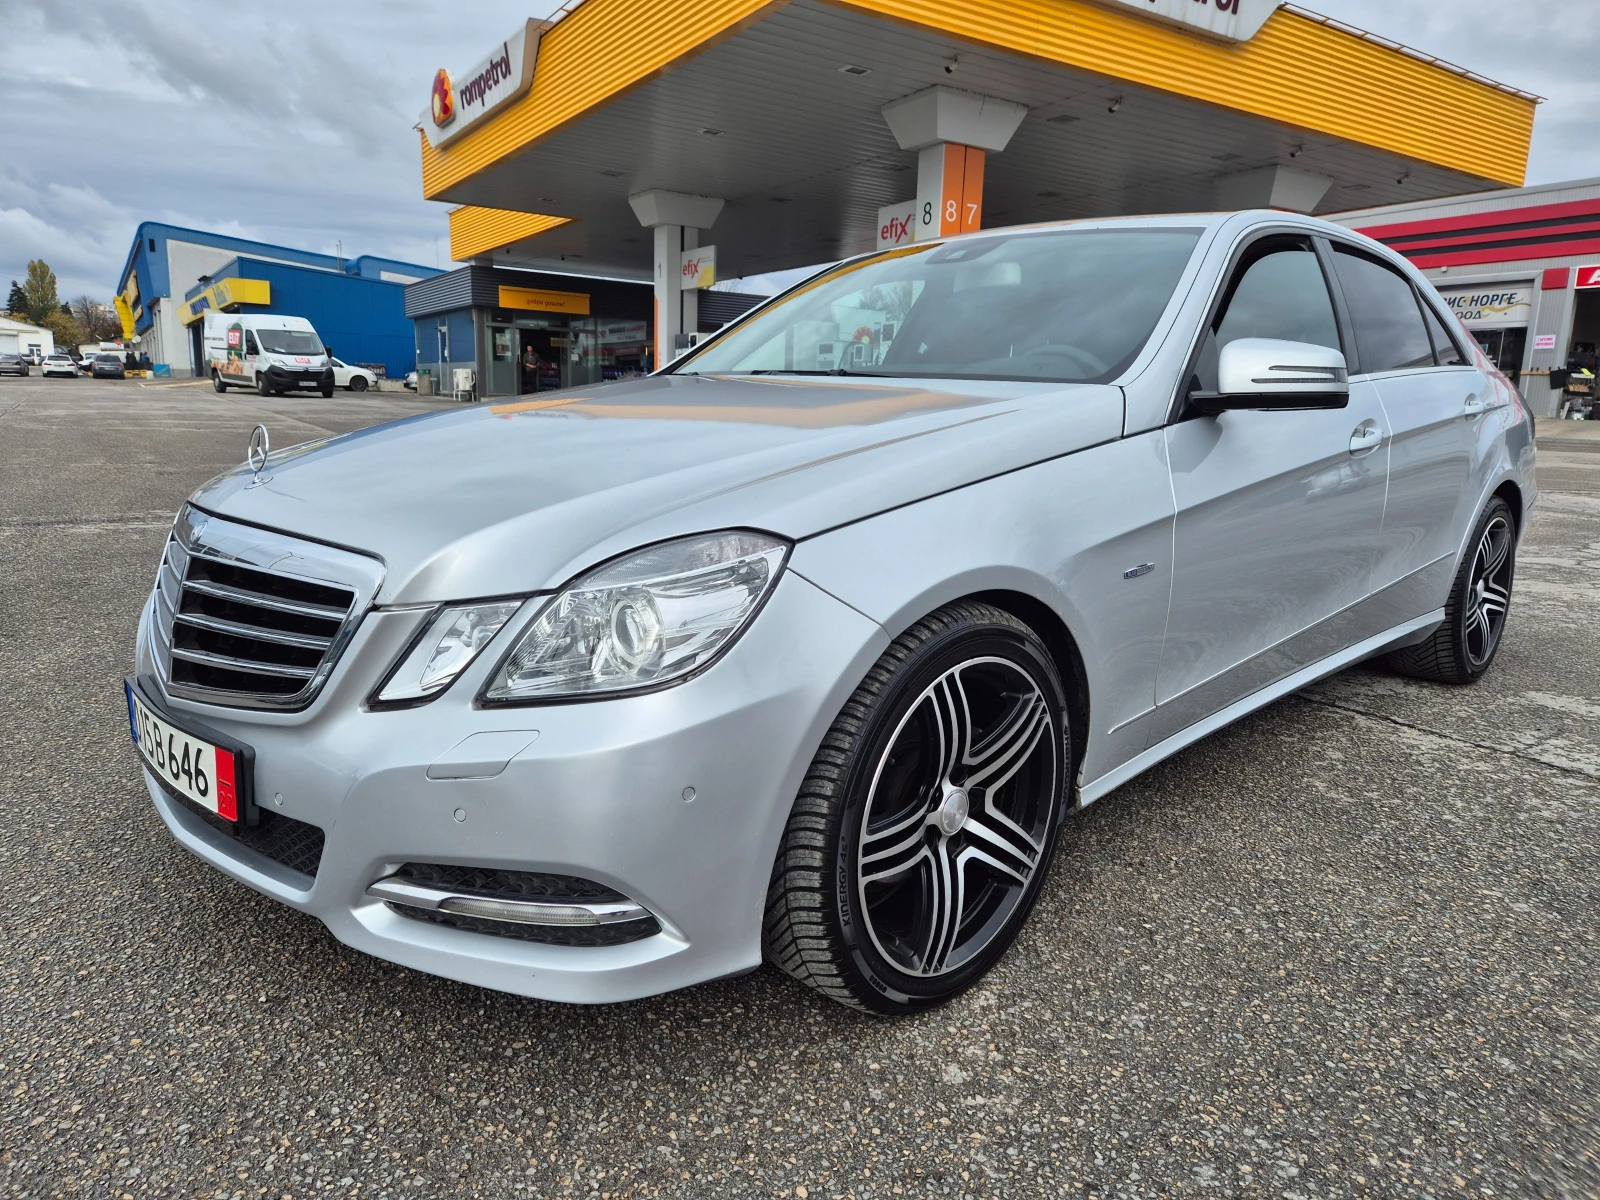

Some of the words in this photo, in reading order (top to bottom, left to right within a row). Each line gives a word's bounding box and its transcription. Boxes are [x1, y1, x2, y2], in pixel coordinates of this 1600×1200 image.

[460, 41, 511, 110] rompetrol
[922, 202, 932, 225] 8
[945, 200, 957, 222] 8
[966, 203, 978, 225] 7
[881, 213, 912, 243] efix
[658, 262, 662, 278] 1
[682, 257, 701, 279] efix
[1468, 292, 1518, 307] НОРГЕ
[839, 865, 851, 927] KINERGY
